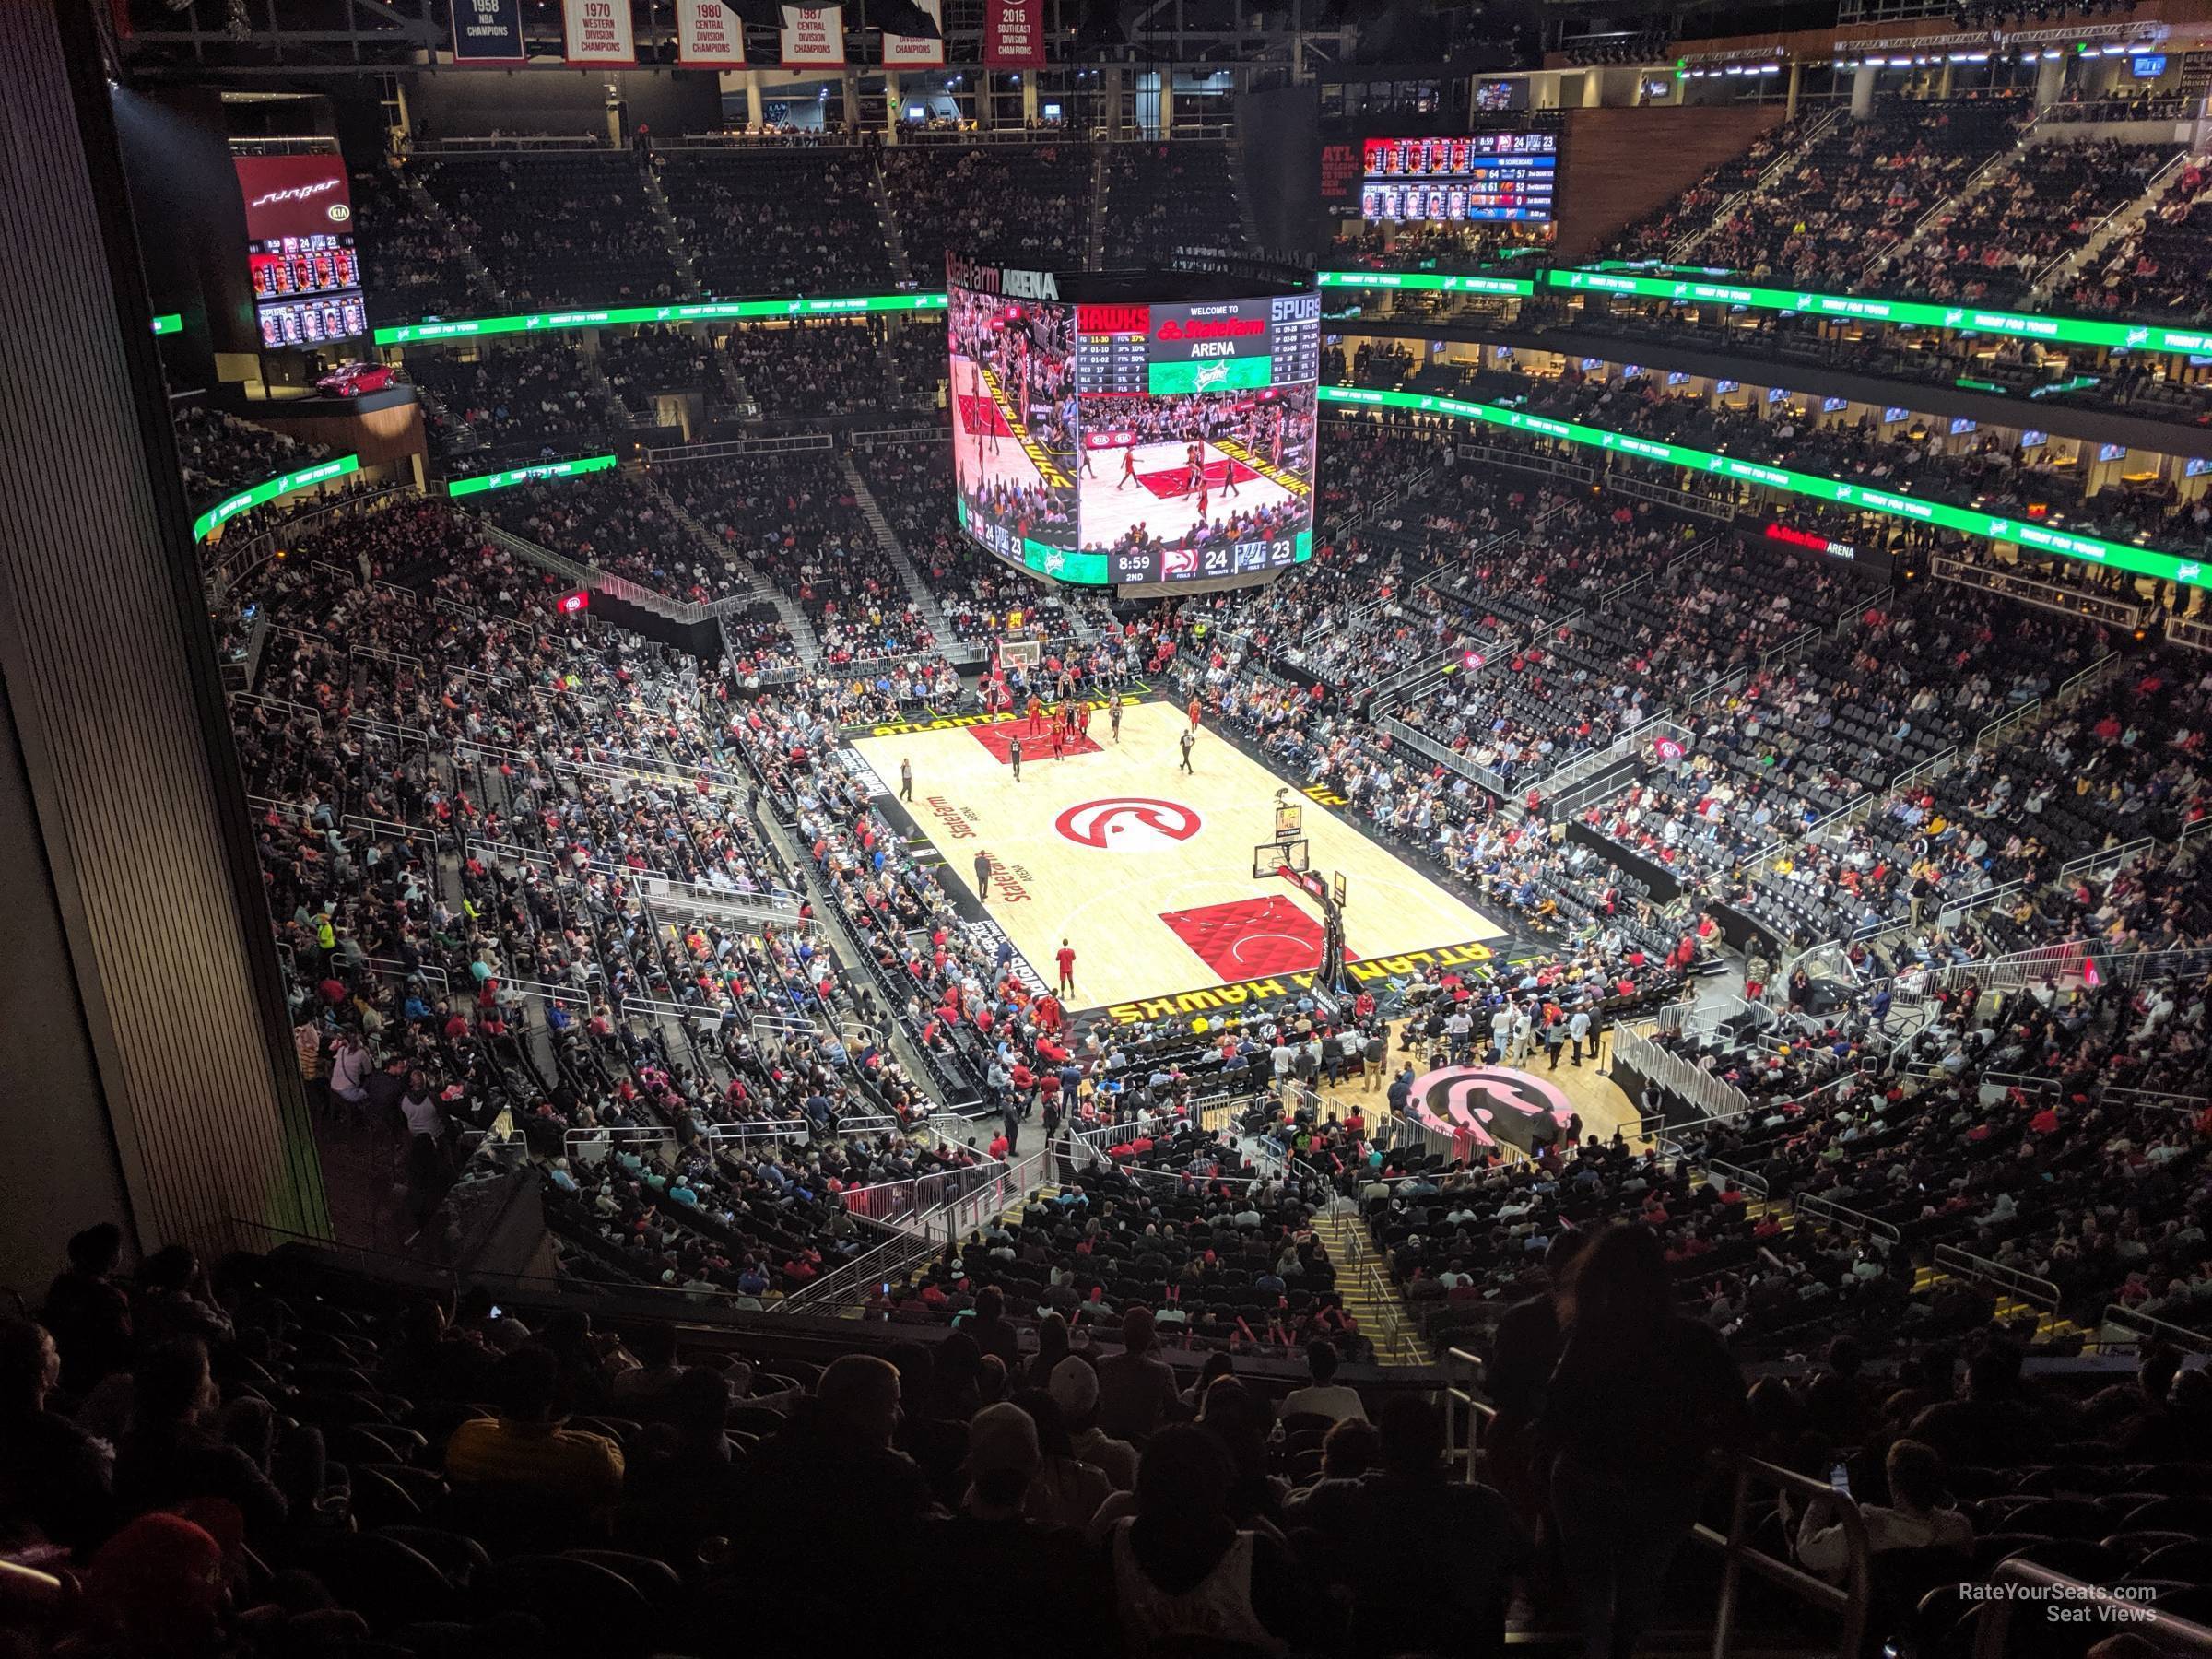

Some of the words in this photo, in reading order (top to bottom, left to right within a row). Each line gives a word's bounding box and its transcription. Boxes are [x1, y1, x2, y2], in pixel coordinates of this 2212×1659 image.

[472, 0, 499, 13] 1958
[584, 4, 611, 17] 1970
[696, 5, 722, 18] 1980
[479, 15, 494, 24] NBA
[1002, 9, 1026, 22] 2015
[582, 19, 615, 29] WESTERN
[695, 21, 724, 30] CENTRAL
[797, 22, 826, 31] CENTRAL
[997, 24, 1031, 34] SOUTHEAST
[467, 27, 509, 37] CHAMPIONS
[585, 30, 615, 41] DIVISION
[697, 32, 724, 41] DIVISION
[798, 33, 826, 42] DIVISION
[1002, 35, 1028, 45] DIVISION
[581, 41, 621, 53] CHAMPIONS
[692, 43, 731, 53] CHAMPIONS
[794, 44, 831, 54] CHAMPIONS
[895, 44, 931, 54] CHAMPIONS
[998, 46, 1033, 56] CHAMPIONS
[1514, 137, 1524, 147] 24
[1543, 137, 1553, 147] 23
[1489, 170, 1499, 178] 64
[1516, 170, 1525, 178] 57
[1488, 182, 1498, 191] 61
[1516, 182, 1524, 191] 52
[1002, 268, 1059, 300] ARENA
[1191, 306, 1227, 315] WELCOME
[1229, 305, 1238, 313] TO
[1272, 298, 1320, 321] SPURS
[1077, 307, 1150, 330] HAWKS
[1974, 314, 2004, 328] THIRST
[2005, 317, 2026, 331] FOR
[2027, 321, 2058, 335] YOURS
[2165, 334, 2202, 348] THIRST
[1191, 341, 1235, 357] ARENA
[985, 523, 994, 542] 24
[1011, 536, 1021, 555] 23
[2052, 535, 2071, 550] FOR
[1119, 556, 1150, 570] 8:59
[1205, 549, 1228, 570] 24
[1271, 540, 1290, 560] 23
[1827, 542, 1854, 559] ARENA
[1125, 573, 1144, 582] 2ND
[872, 712, 1017, 736] ATLANTA
[926, 795, 977, 840] StateFarm
[959, 806, 980, 821] ARENA
[1011, 864, 1034, 882] ARENA
[1292, 943, 1497, 988] ATLANA
[1107, 979, 1288, 1023] HAWKS
